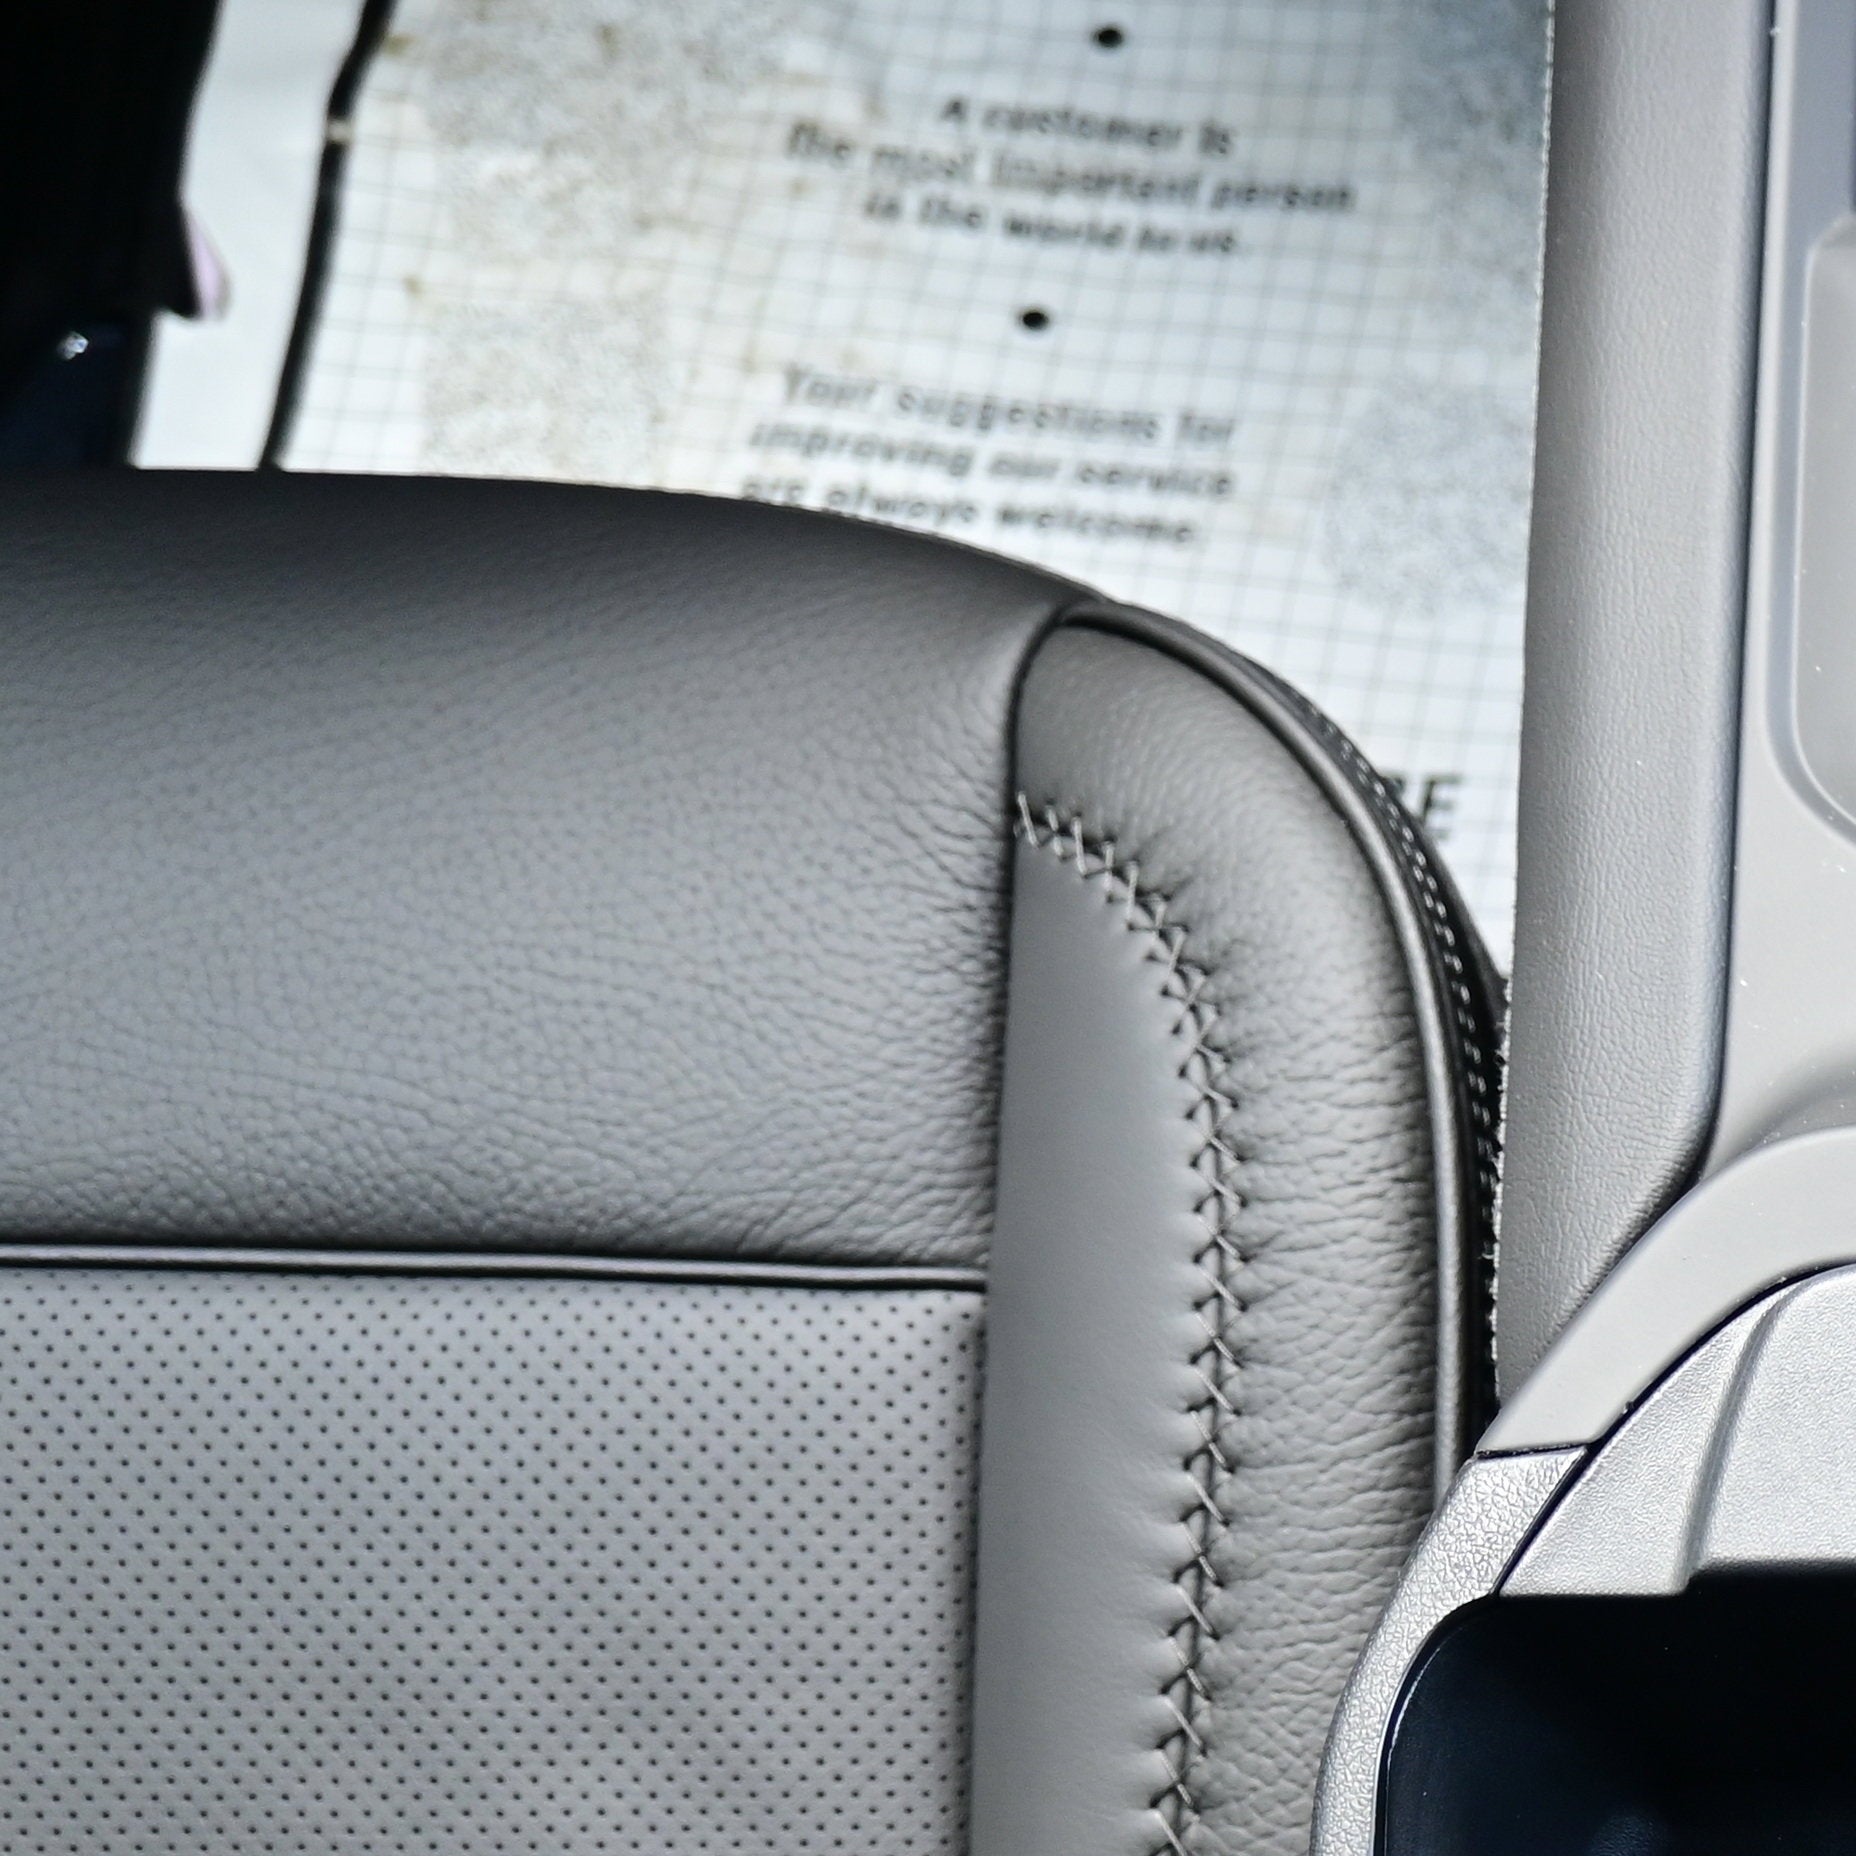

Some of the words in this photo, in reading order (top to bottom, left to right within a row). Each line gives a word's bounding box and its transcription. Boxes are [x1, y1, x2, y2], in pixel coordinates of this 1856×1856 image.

[942, 97, 970, 125] A
[983, 103, 1182, 150] customer
[1197, 117, 1232, 157] is
[869, 143, 975, 184] most
[990, 152, 1200, 200] important
[1208, 178, 1355, 213] person
[917, 196, 988, 229] the
[1003, 211, 1126, 249] world
[1137, 224, 1176, 254] to
[784, 363, 878, 408] Your
[897, 383, 1160, 443] suggestions
[1175, 406, 1235, 443] for
[749, 422, 974, 478] improving
[987, 453, 1061, 482] our
[1074, 461, 1235, 497] service
[828, 481, 980, 526] always
